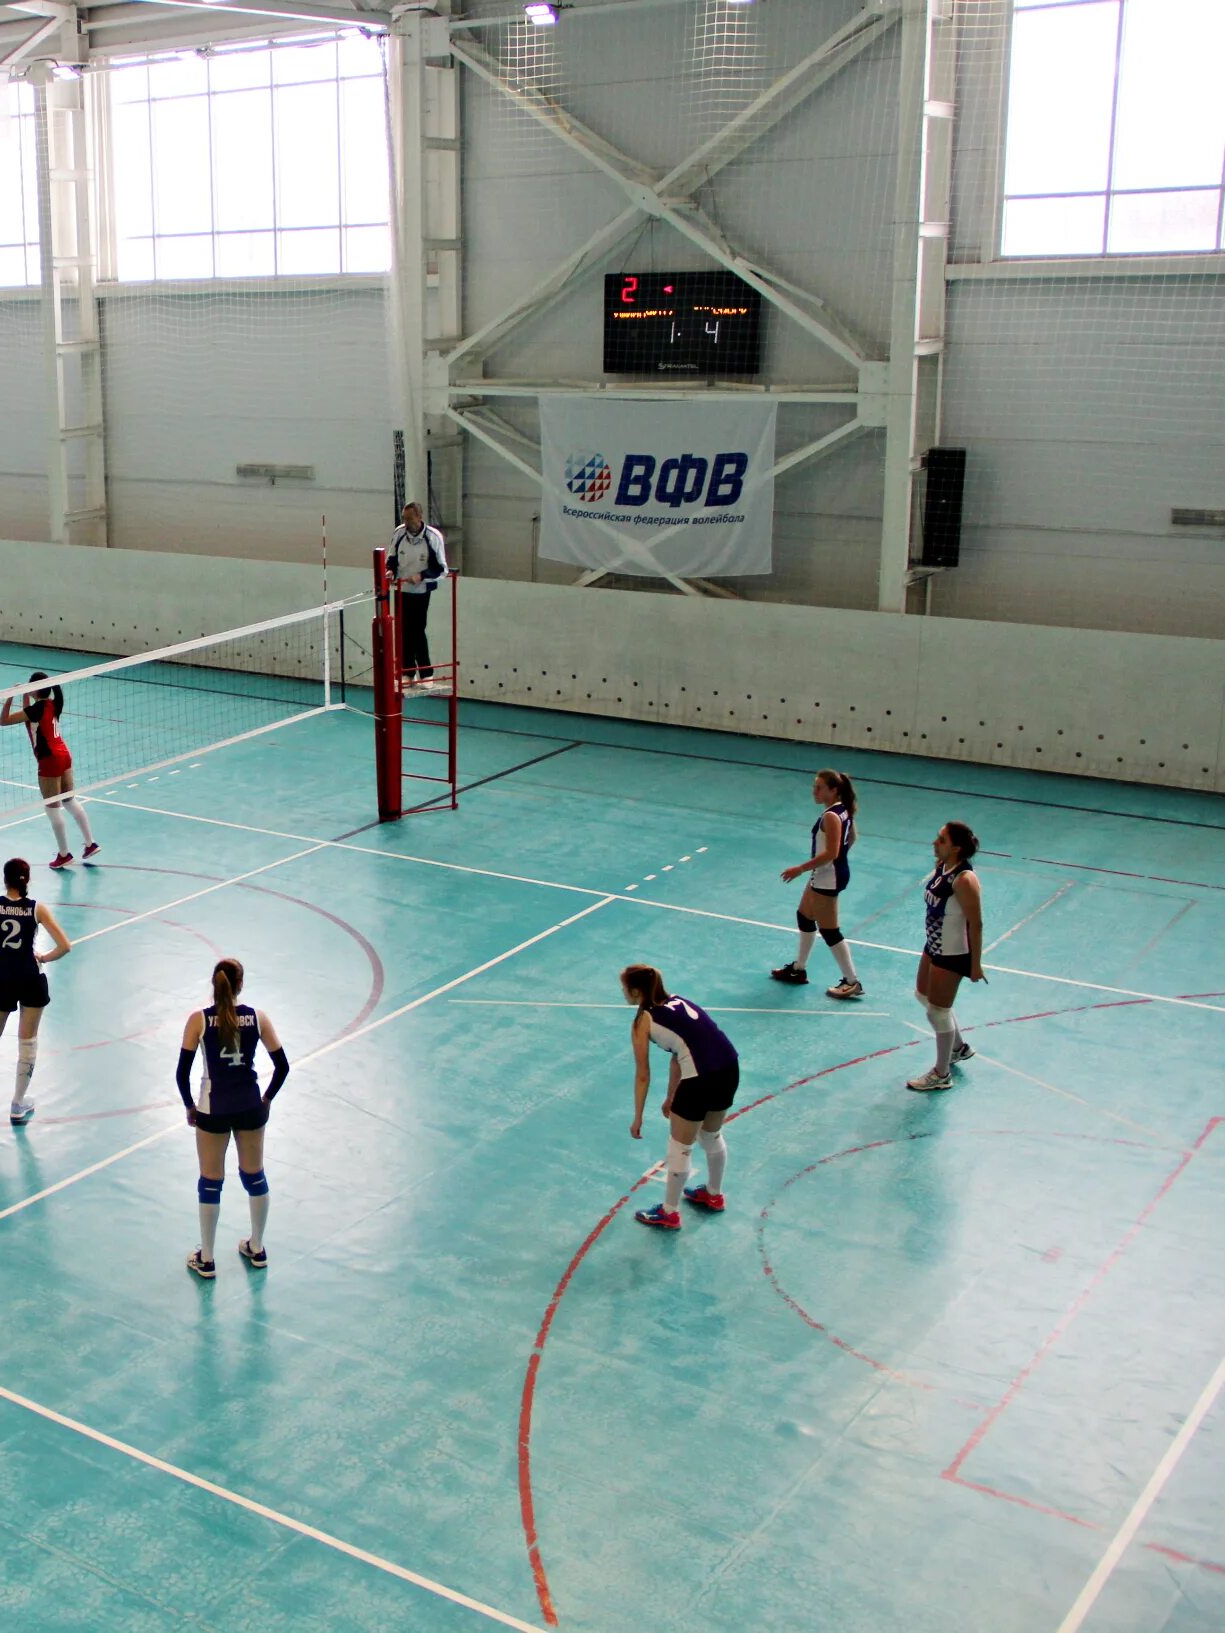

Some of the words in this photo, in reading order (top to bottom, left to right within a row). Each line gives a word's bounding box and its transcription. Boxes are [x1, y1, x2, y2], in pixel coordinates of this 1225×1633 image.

[621, 276, 639, 303] 2
[704, 320, 720, 344] 4
[614, 452, 749, 508] ВФВ
[562, 505, 631, 524] Всероссийская
[633, 514, 690, 526] федерация
[691, 513, 745, 526] волейбола
[930, 875, 943, 890] 9
[0, 919, 23, 949] 2
[219, 1030, 246, 1066] 4
